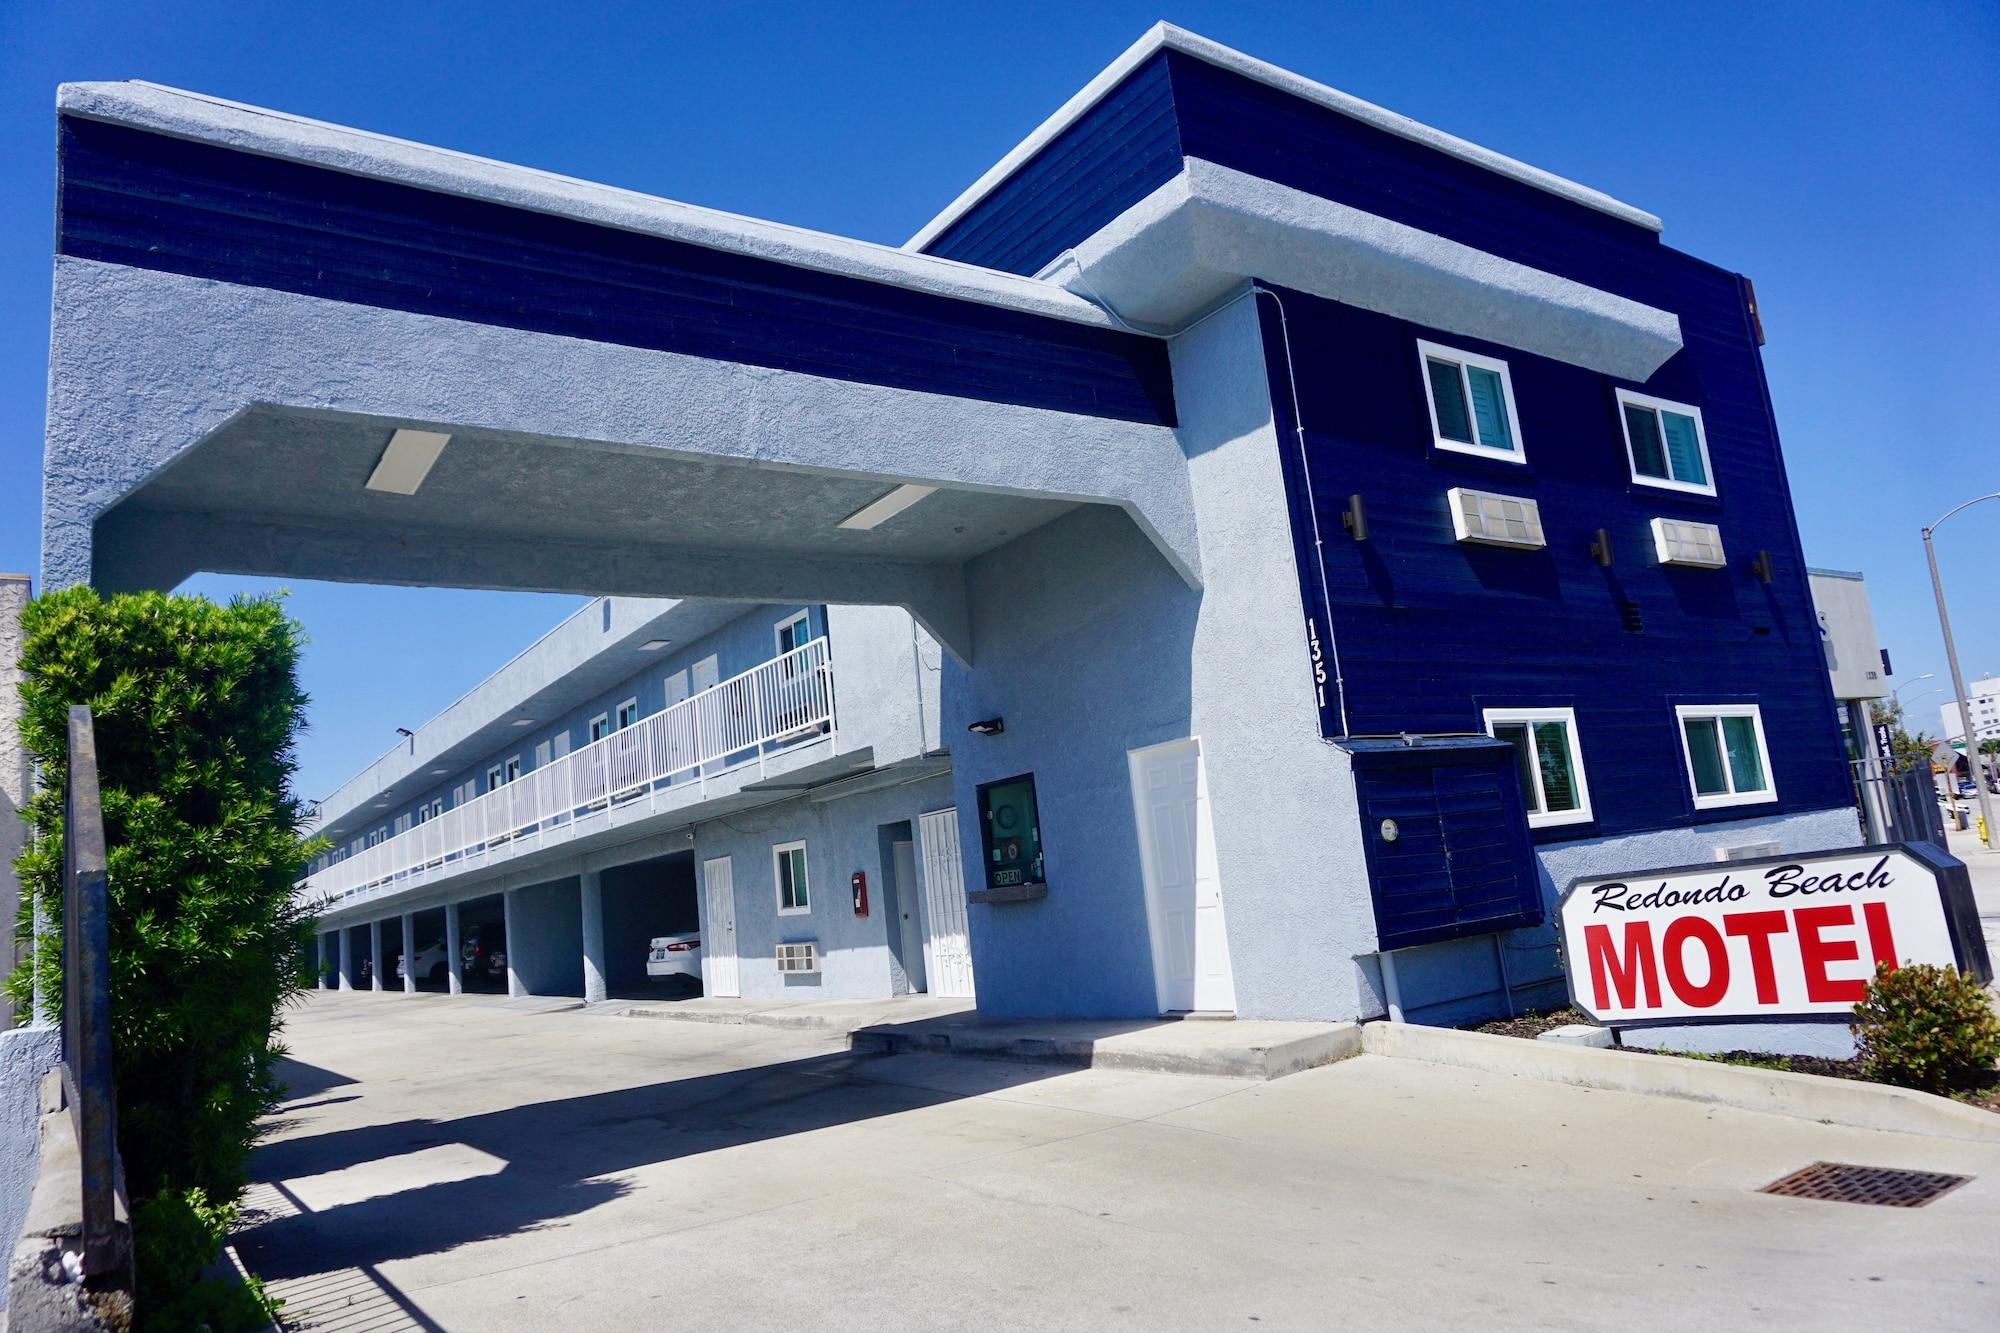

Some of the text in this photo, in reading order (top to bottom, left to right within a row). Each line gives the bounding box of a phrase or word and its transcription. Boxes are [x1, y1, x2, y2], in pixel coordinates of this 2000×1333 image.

[1309, 618, 1327, 708] 1351
[996, 871, 1020, 883] OPEN
[1591, 855, 1896, 914] Redondo Beach
